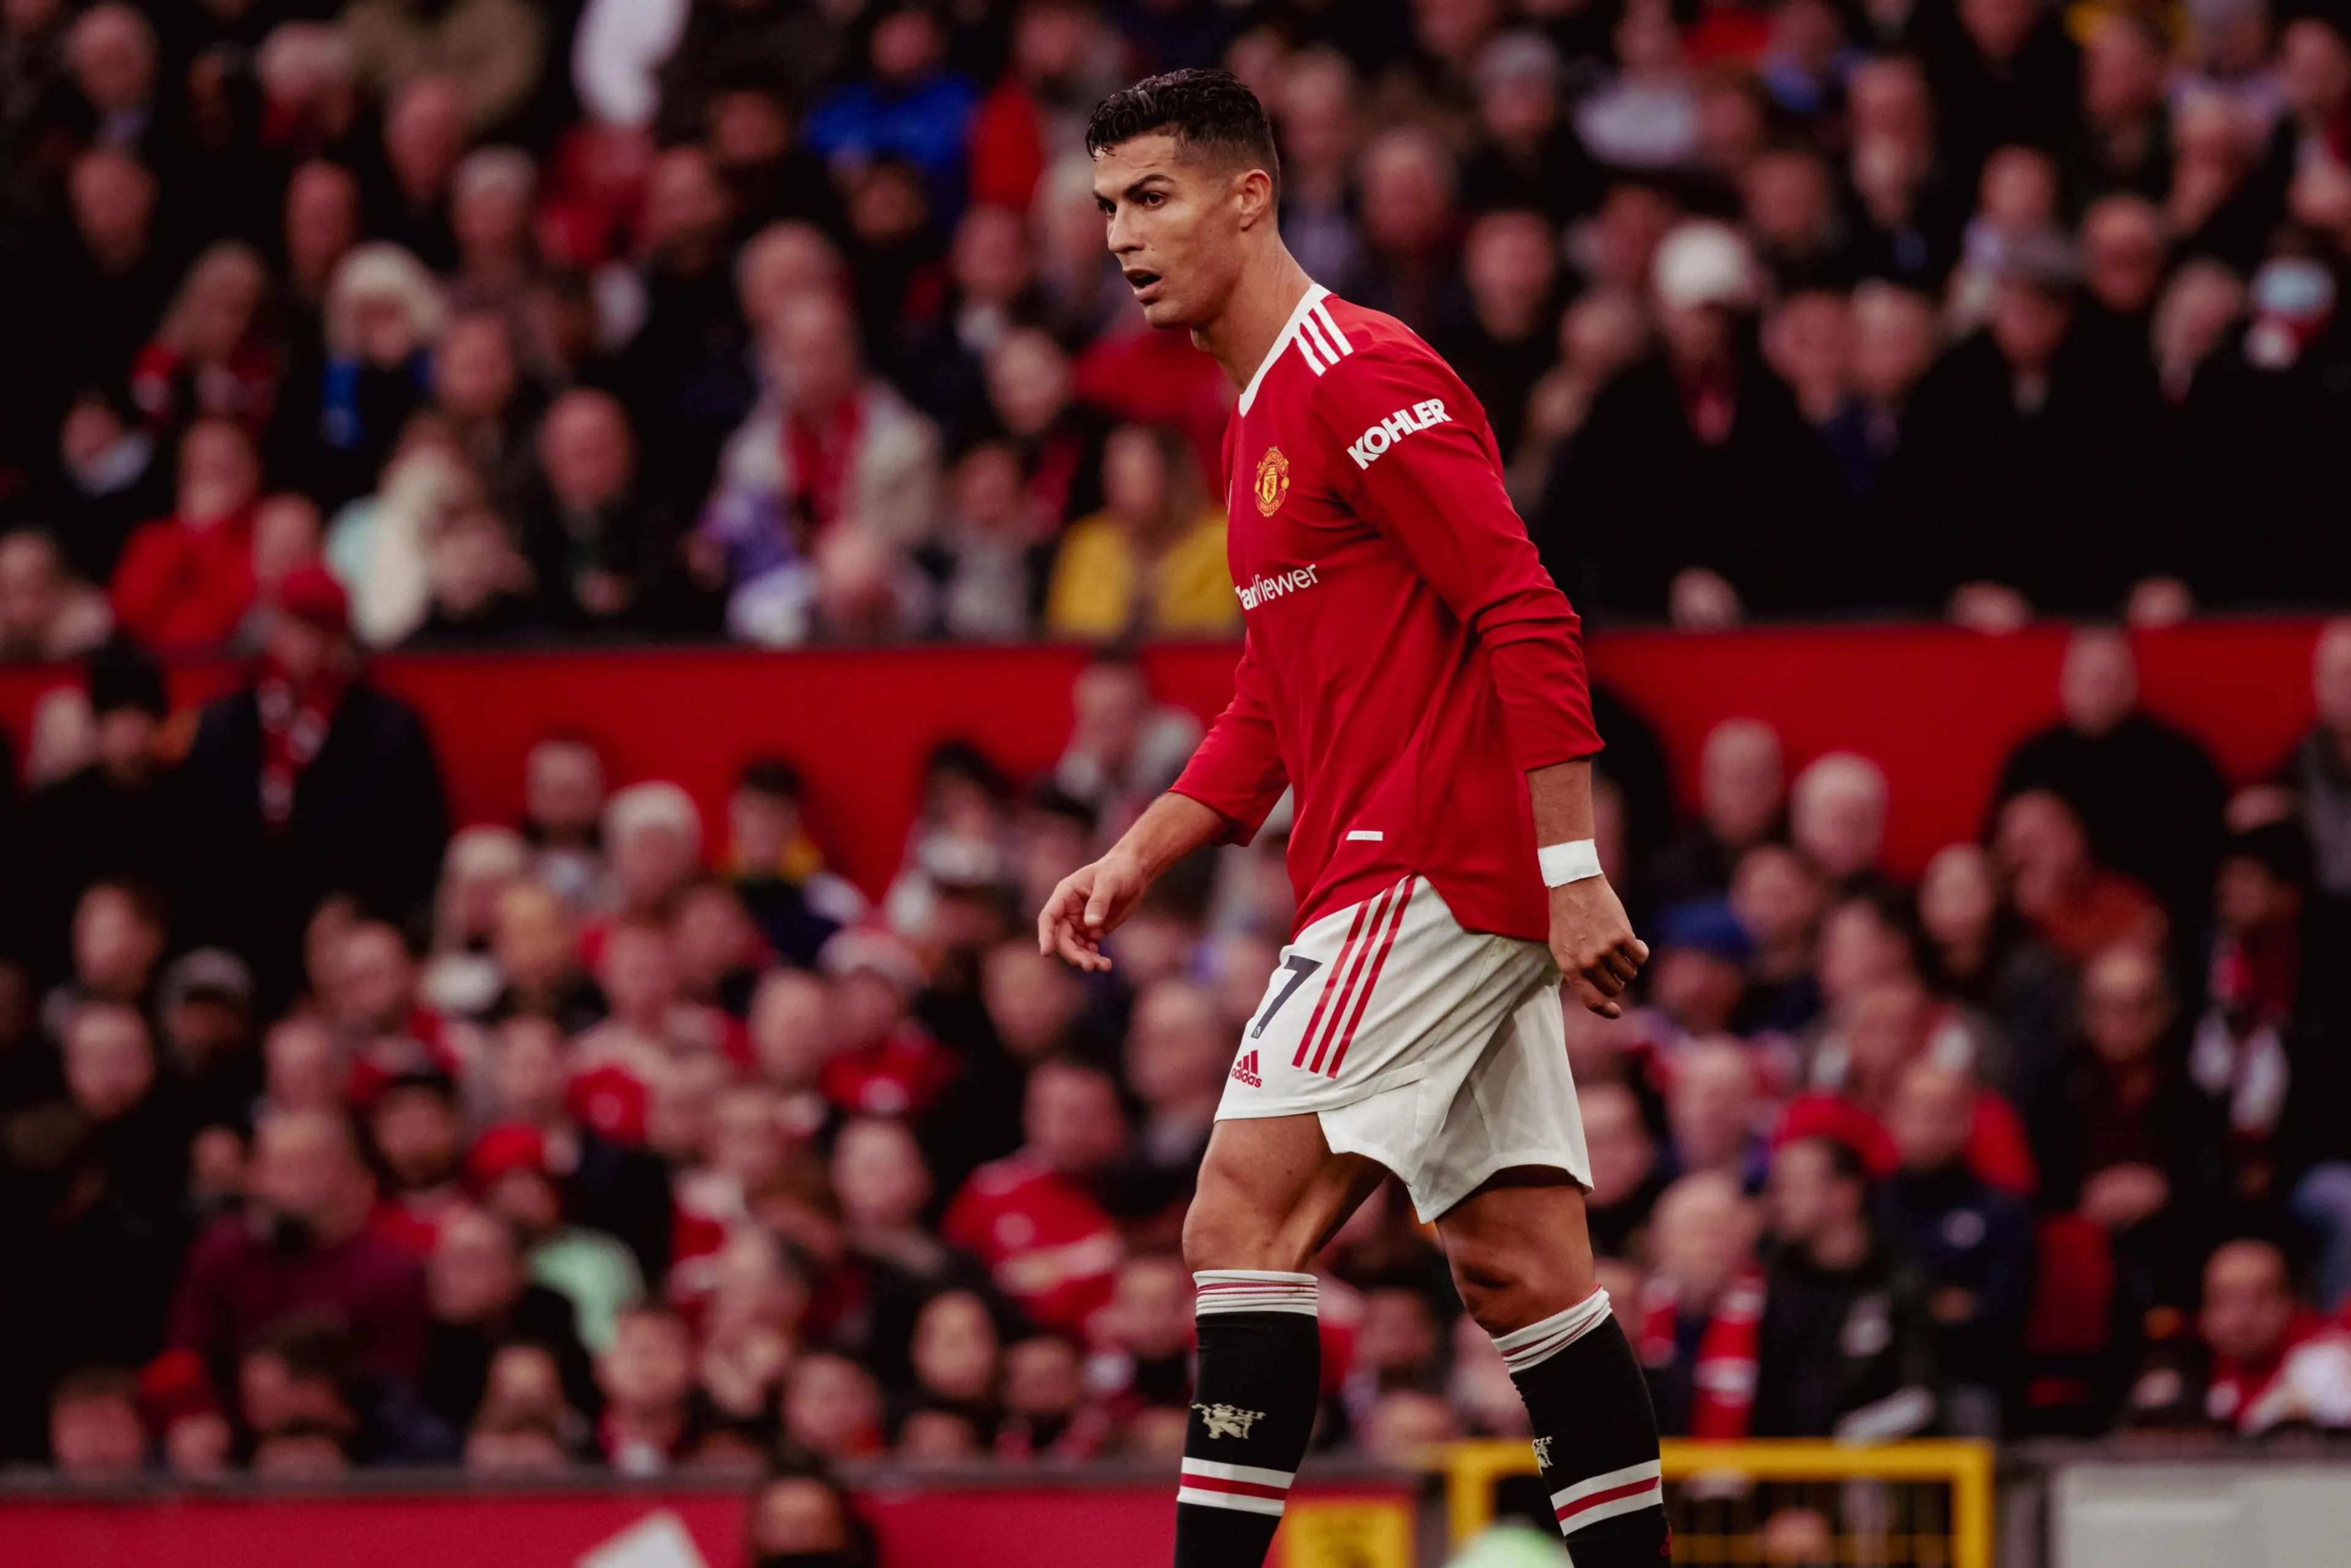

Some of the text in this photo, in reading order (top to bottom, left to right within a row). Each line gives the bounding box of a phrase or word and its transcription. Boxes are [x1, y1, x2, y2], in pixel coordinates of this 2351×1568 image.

[1347, 398, 1453, 471] KOHLER
[1251, 955, 1323, 1040] 7
[1231, 1067, 1262, 1088] adidas
